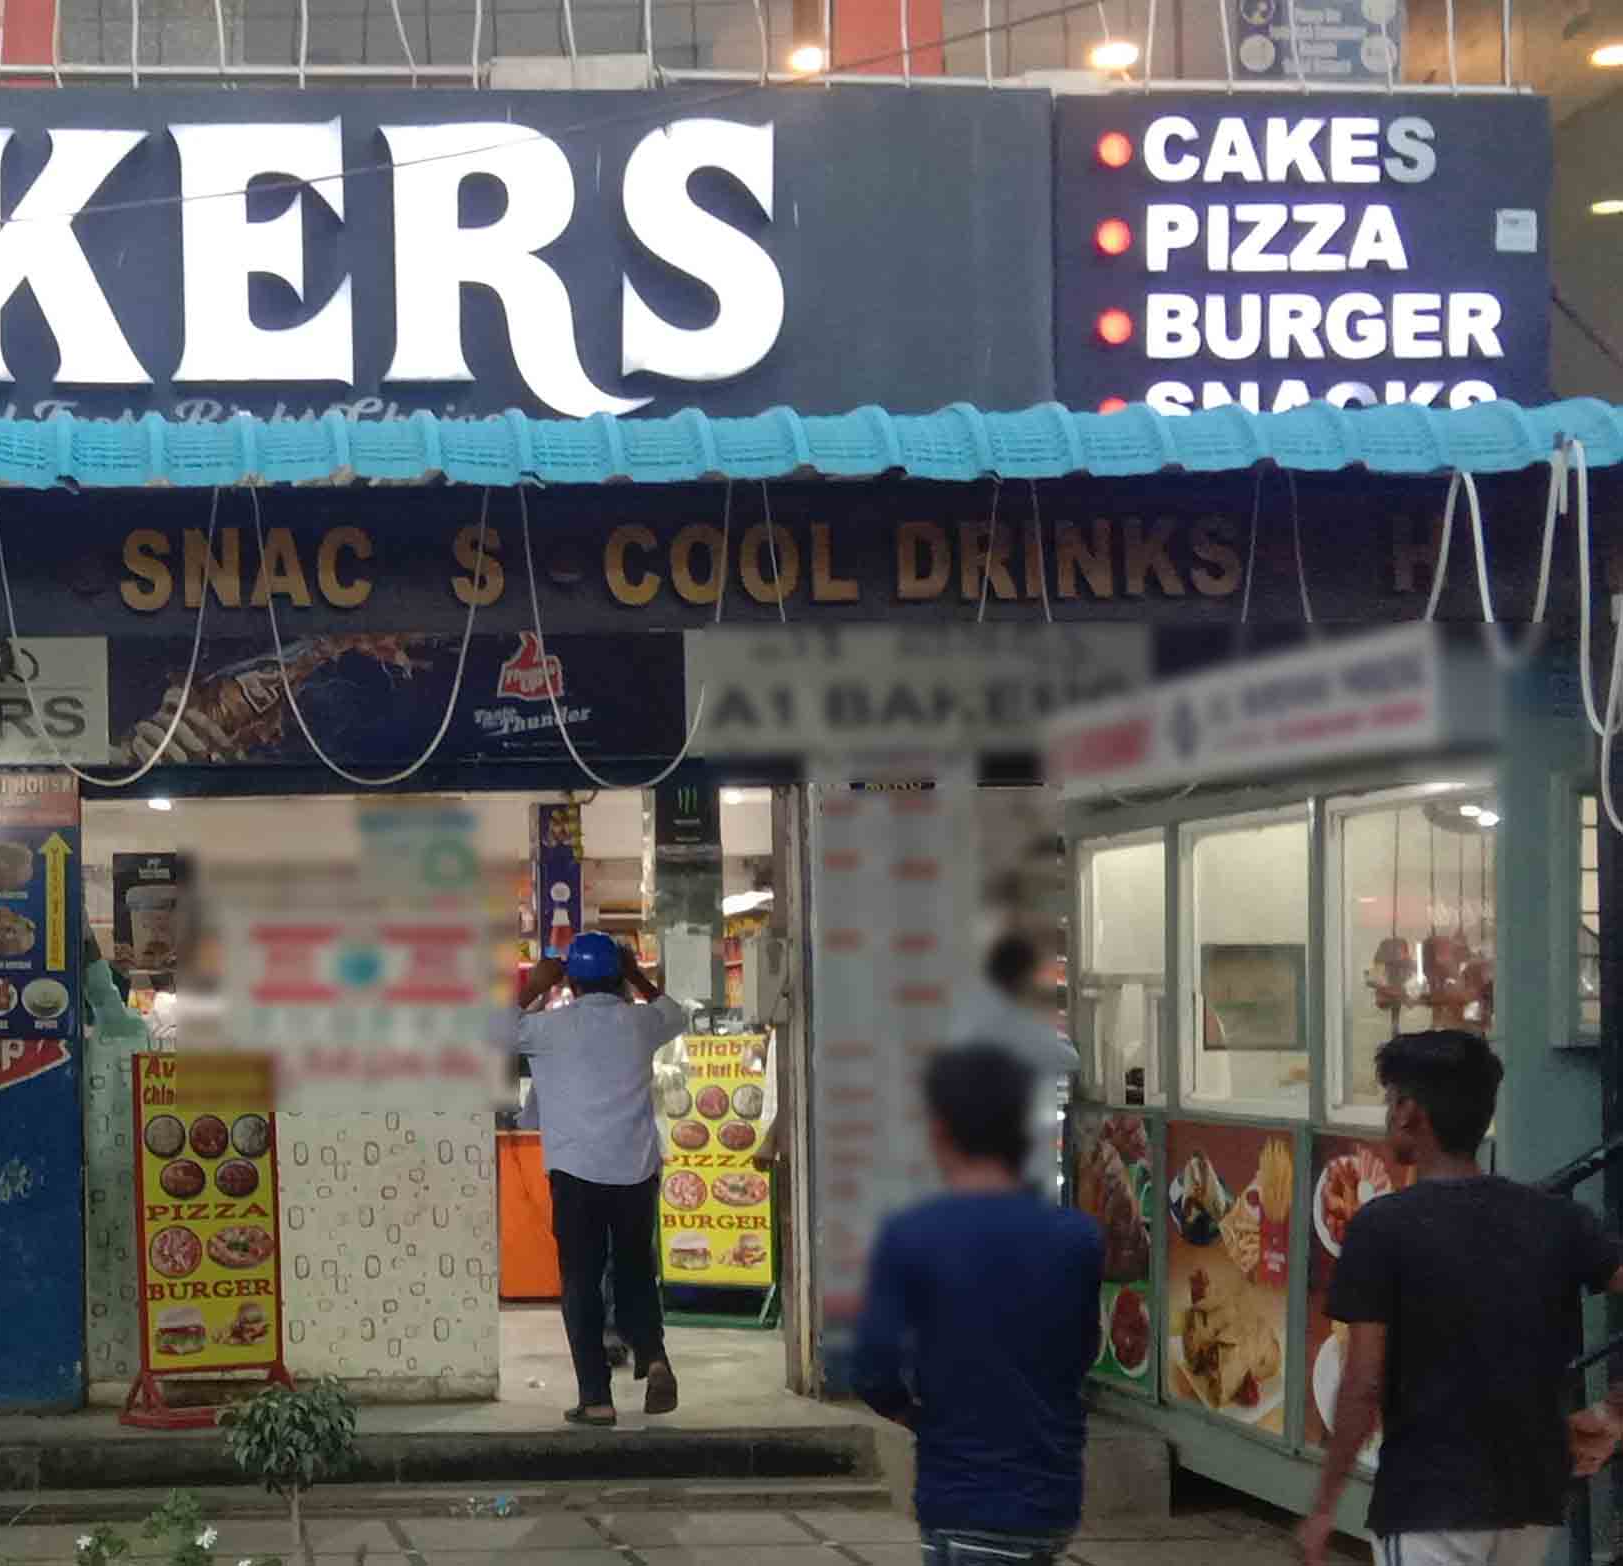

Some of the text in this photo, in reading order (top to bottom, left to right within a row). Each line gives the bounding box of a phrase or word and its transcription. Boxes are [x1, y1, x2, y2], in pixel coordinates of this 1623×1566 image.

[1143, 115, 1438, 185] CAKES
[1144, 203, 1409, 273] PIZZA
[1144, 292, 1505, 361] BURGER
[603, 522, 861, 609] COOL
[895, 518, 1244, 603] DRINKS
[146, 1202, 270, 1222] PIZZA
[663, 1214, 769, 1230] BURGER
[147, 1279, 275, 1301] BURGER
